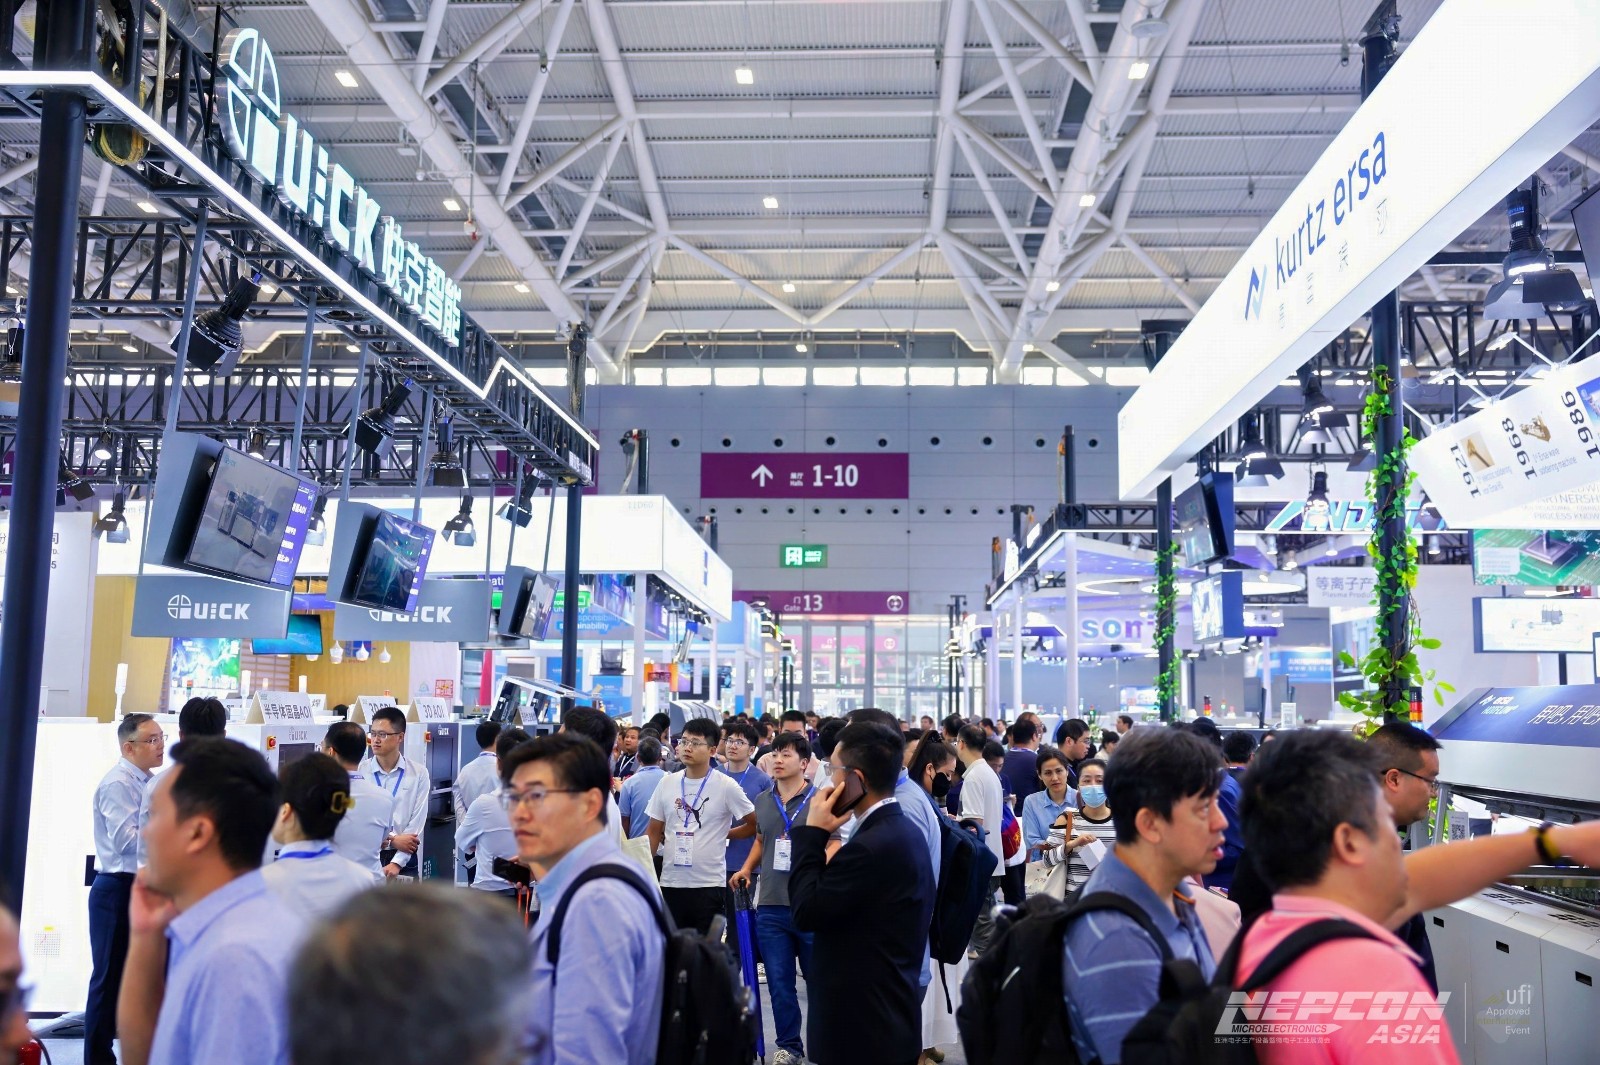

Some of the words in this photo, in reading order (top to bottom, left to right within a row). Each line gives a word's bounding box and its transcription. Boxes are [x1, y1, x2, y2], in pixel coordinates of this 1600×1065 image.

[1276, 200, 1326, 290] kurtz
[1333, 131, 1387, 226] ersa
[383, 215, 461, 348] 快克智能
[1501, 417, 1537, 480] 1968
[1561, 391, 1600, 459] 1986
[813, 464, 859, 487] 1-10
[1450, 443, 1482, 498] 1921
[167, 594, 250, 621] QUICK
[784, 604, 801, 612] Gate
[803, 595, 823, 611] 13
[1316, 576, 1379, 591] 等离子产
